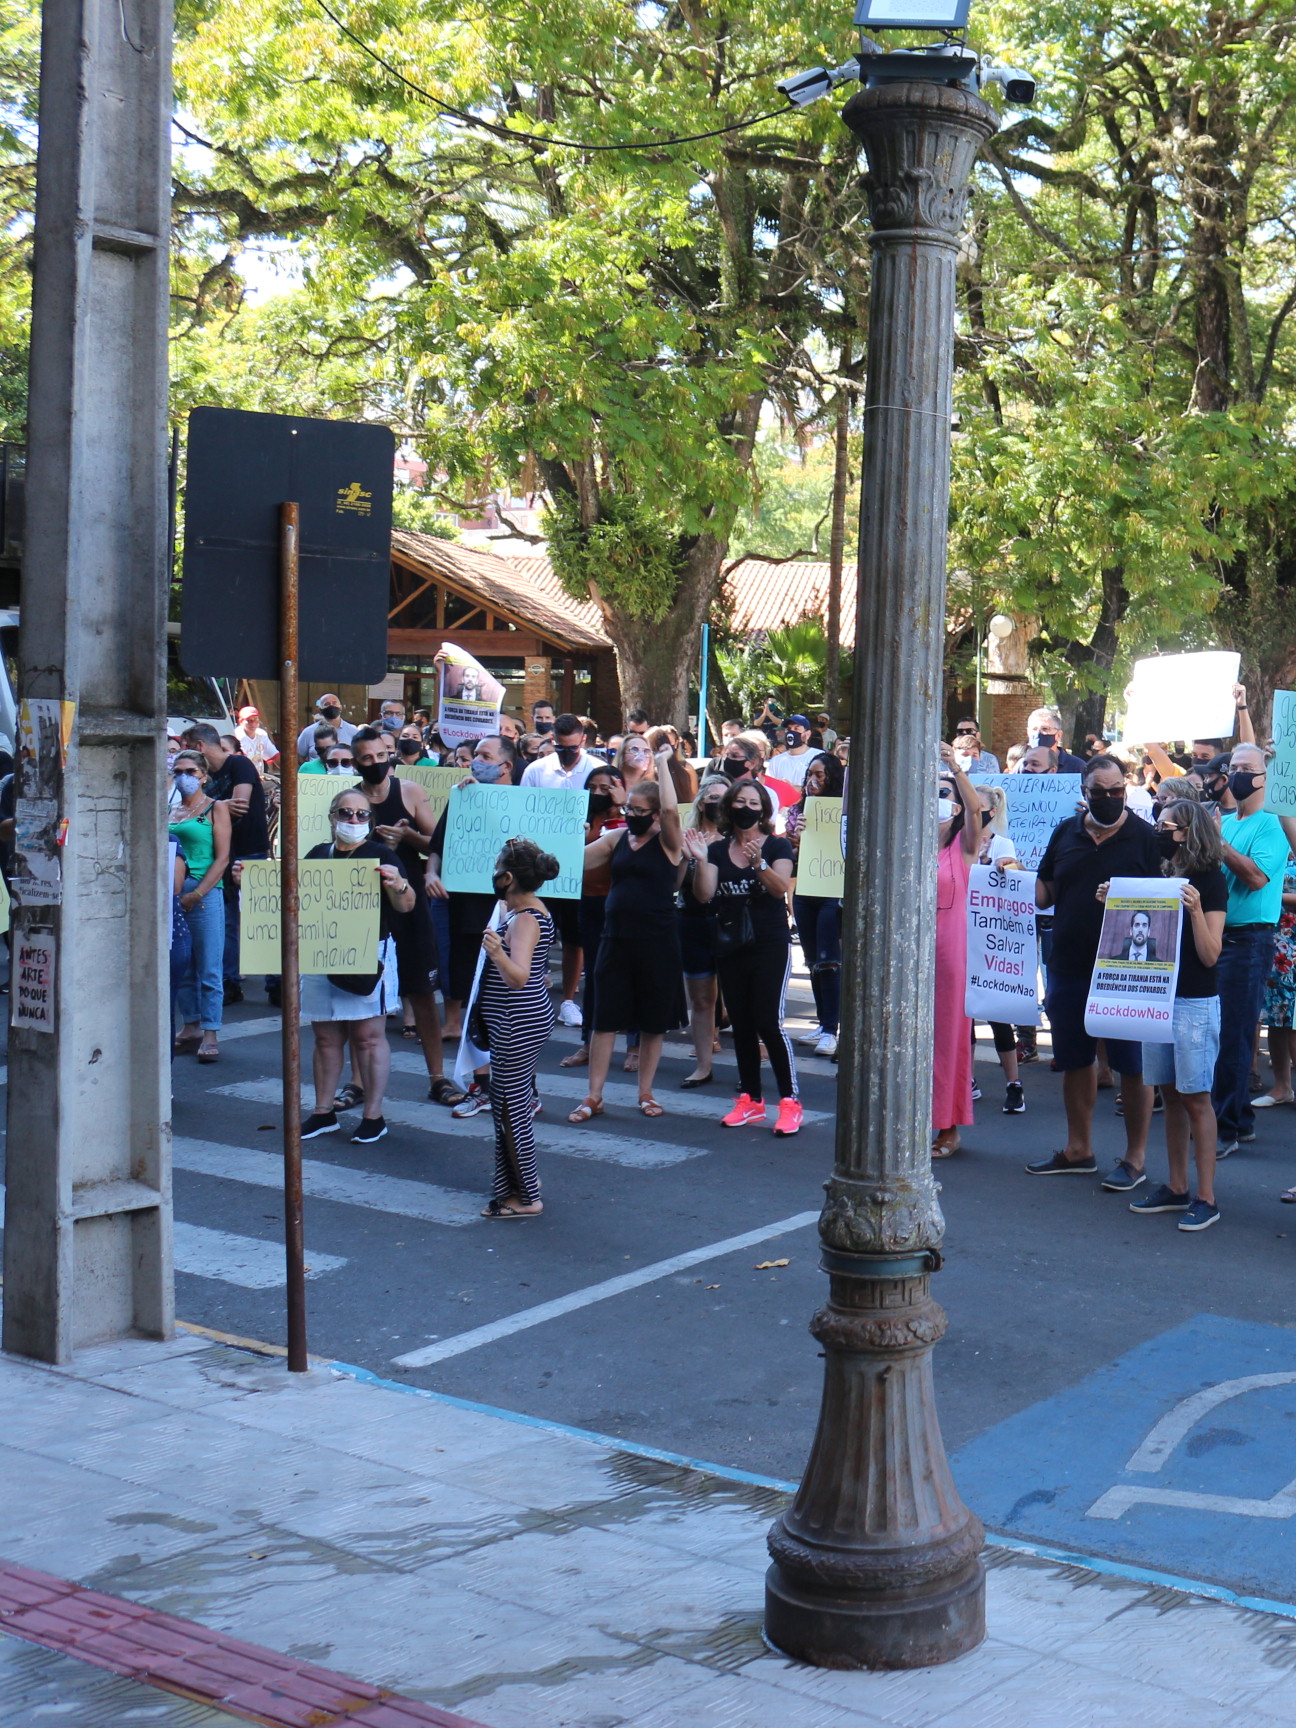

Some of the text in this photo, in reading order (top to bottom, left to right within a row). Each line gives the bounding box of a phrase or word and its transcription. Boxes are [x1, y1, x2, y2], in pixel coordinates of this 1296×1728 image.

[442, 727, 486, 740] #LockdowN
[970, 890, 1035, 917] Empregos
[971, 911, 1034, 936] Também é
[986, 934, 1025, 955] Salvar
[19, 947, 48, 965] ANTES
[984, 954, 1025, 976] Vidas!
[21, 968, 44, 985] ARTE
[1102, 973, 1119, 983] FORÇA
[1128, 974, 1149, 983] TIRANIA
[1149, 974, 1162, 983] ESTÁ
[1163, 976, 1170, 984] NA
[970, 975, 1035, 998] #LockdowNao
[1096, 982, 1168, 995] OBEDIÊNCIA DOS COVARDES.
[1088, 1002, 1170, 1020] #LockdowNao
